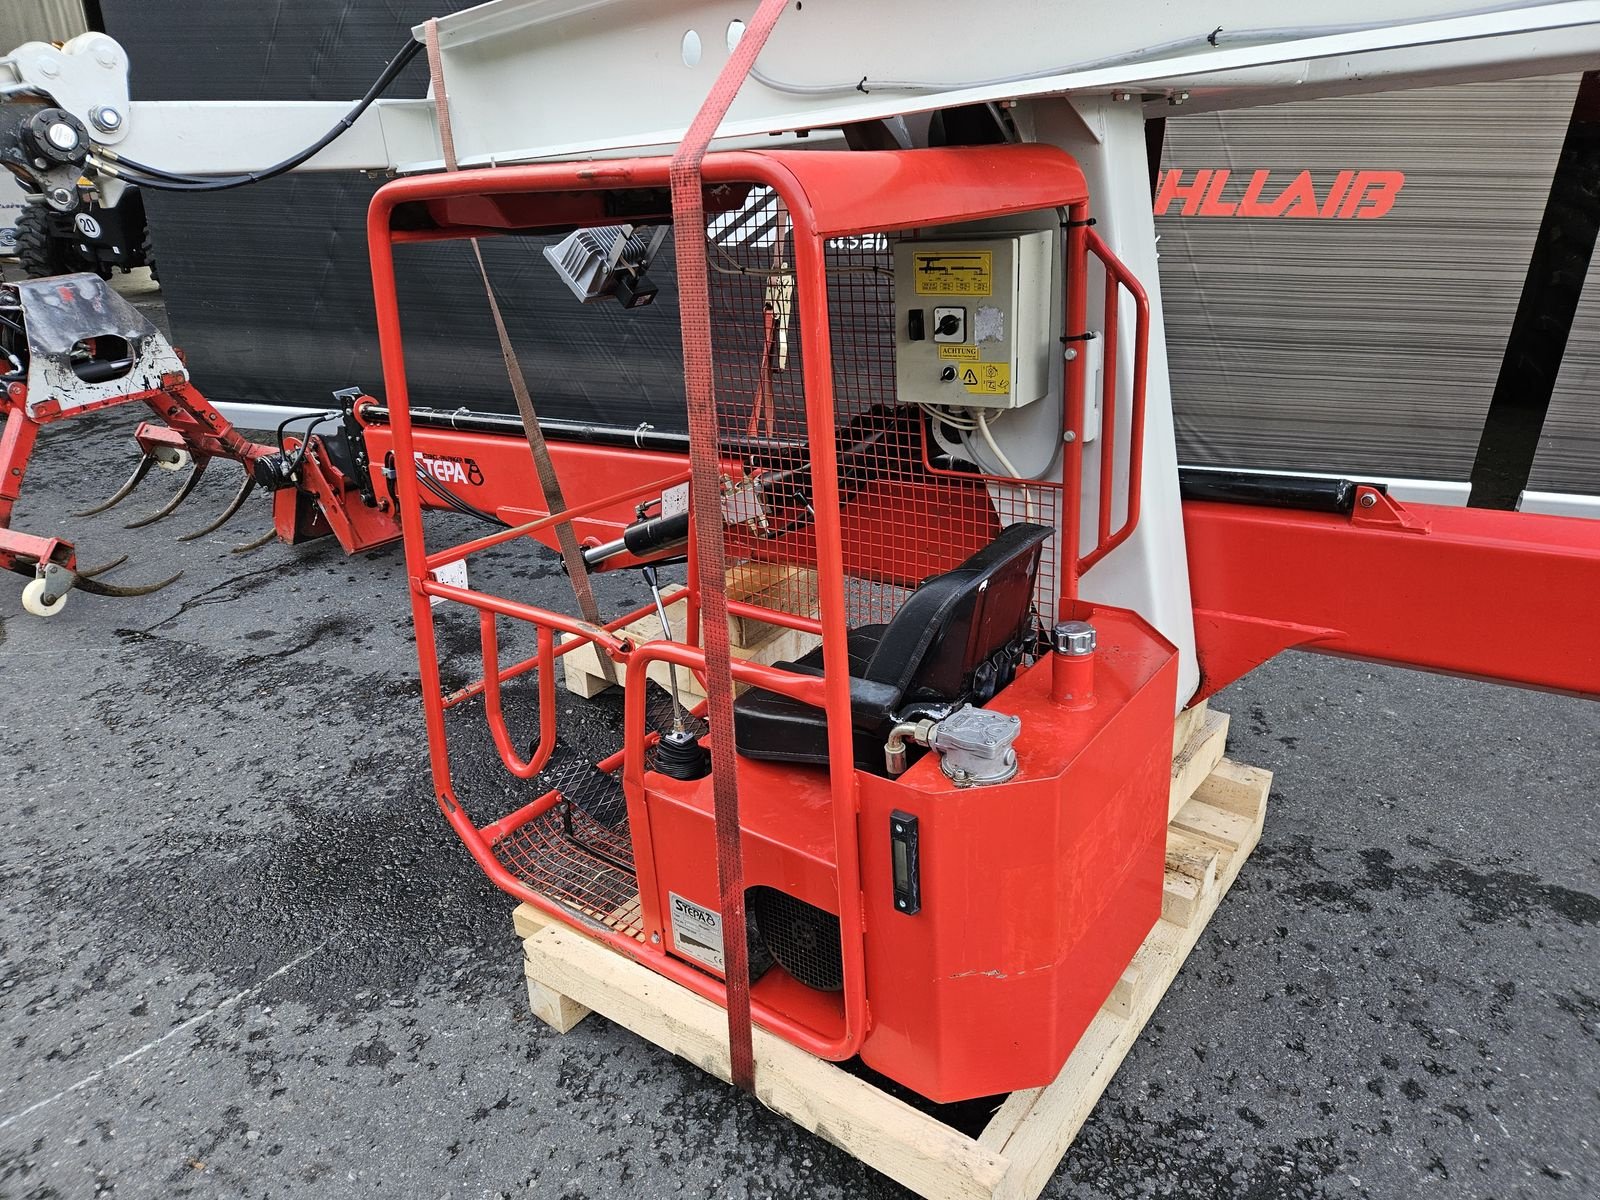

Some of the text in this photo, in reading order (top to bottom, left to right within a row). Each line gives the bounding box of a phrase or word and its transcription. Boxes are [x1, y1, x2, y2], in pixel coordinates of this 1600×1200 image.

[1153, 169, 1406, 219] HLLAIB
[79, 218, 96, 232] 20
[942, 346, 977, 355] ACHTUNG
